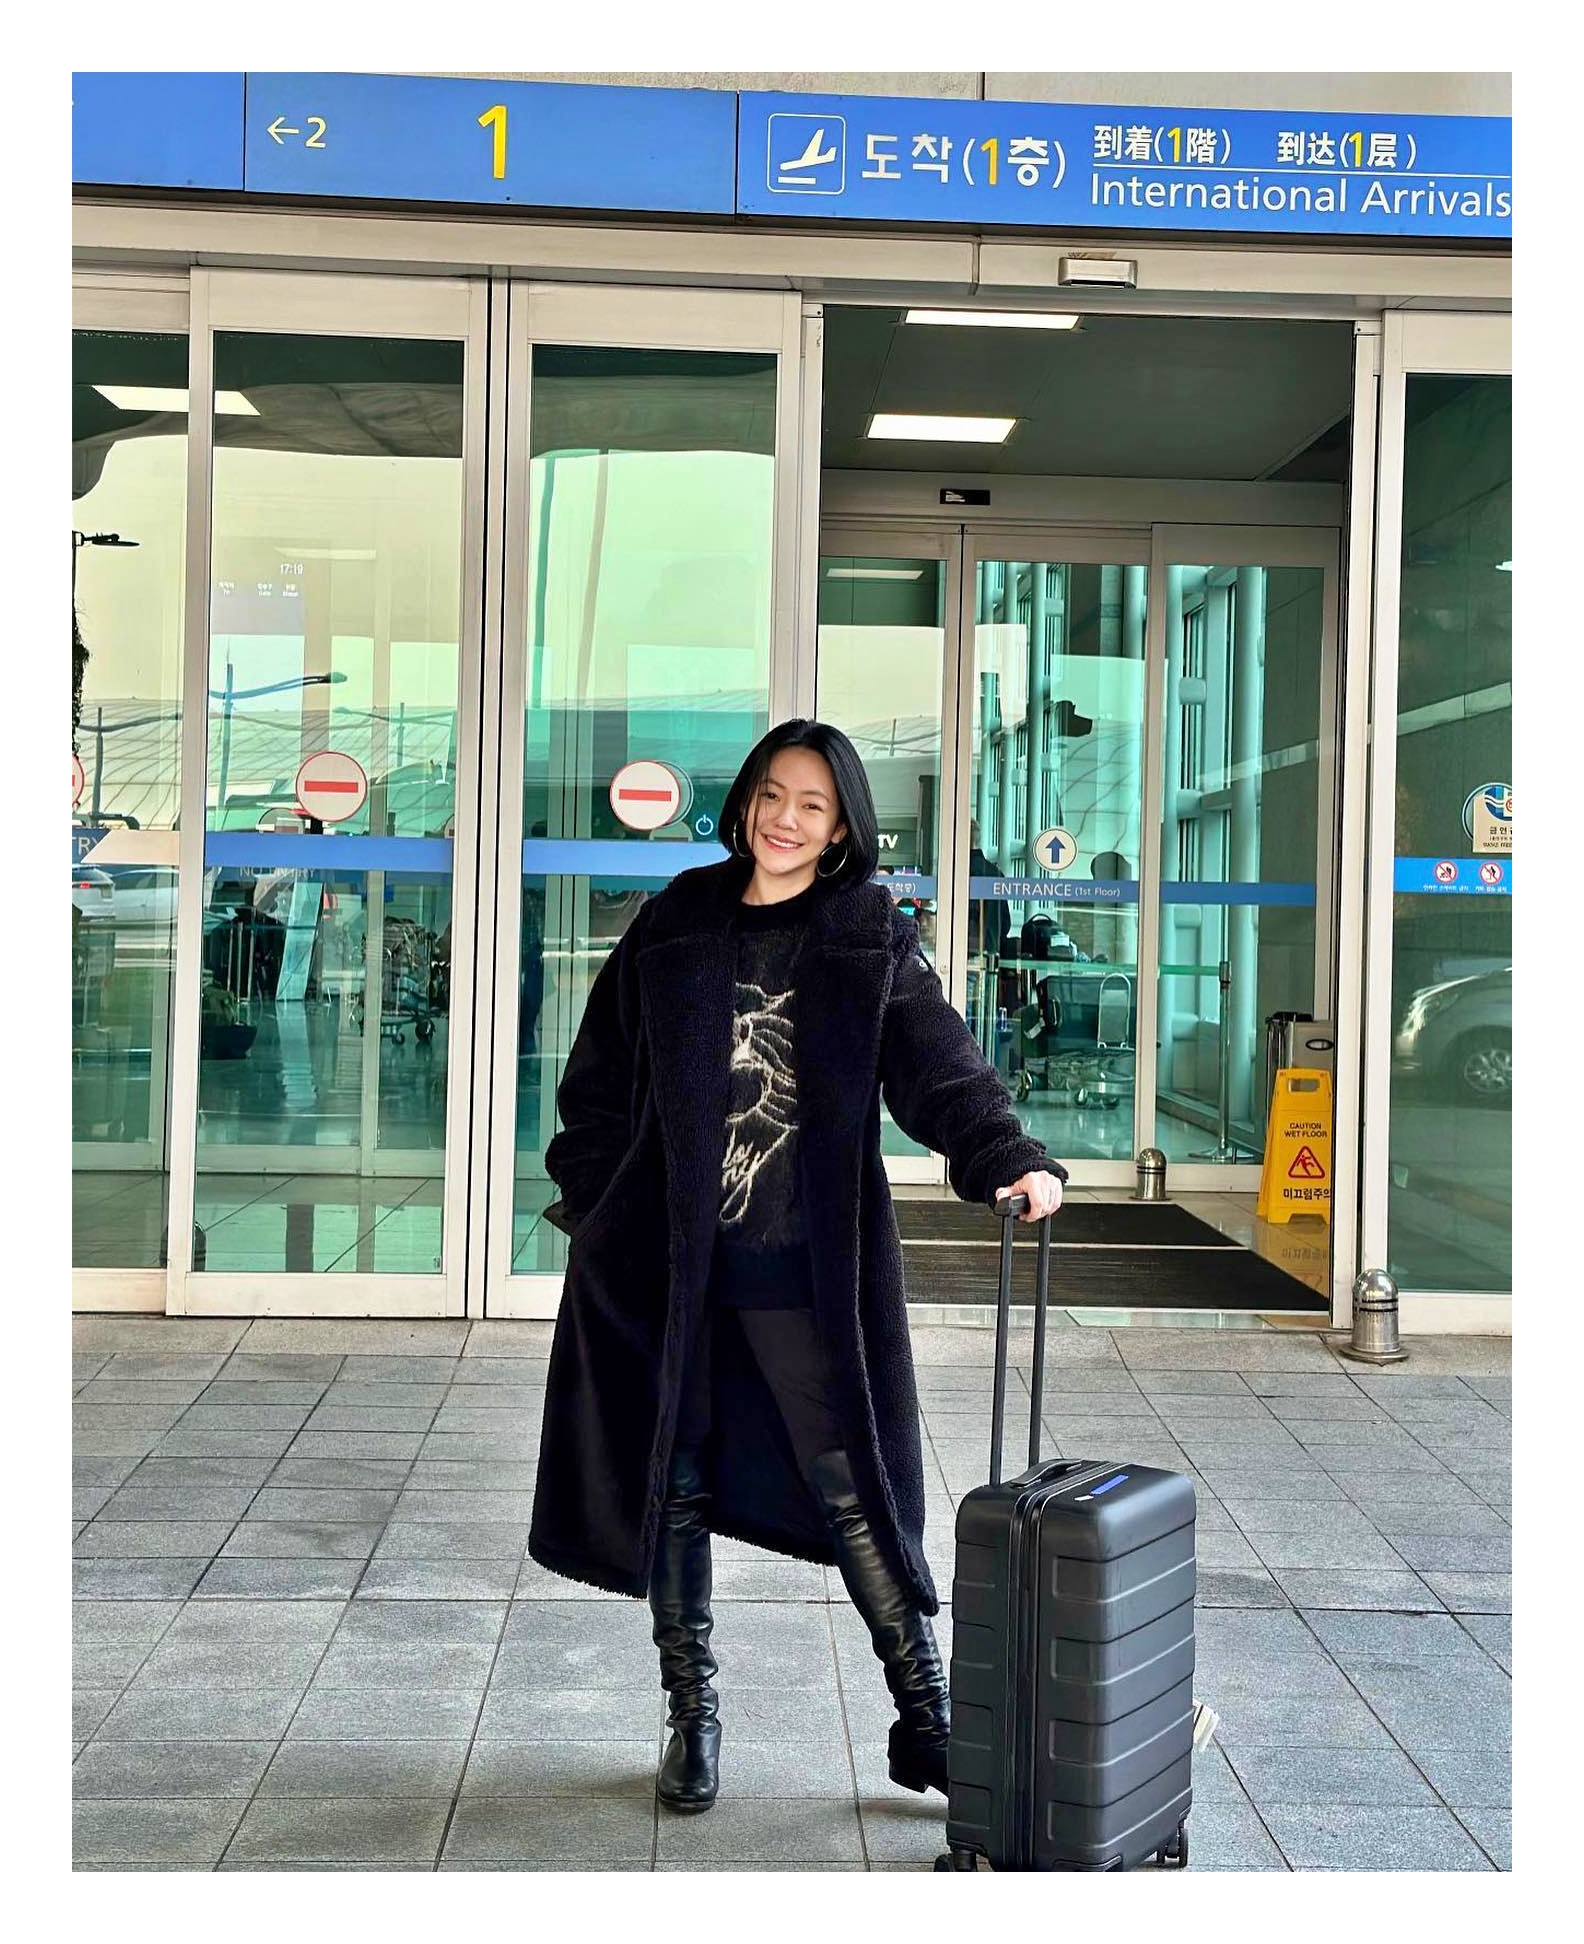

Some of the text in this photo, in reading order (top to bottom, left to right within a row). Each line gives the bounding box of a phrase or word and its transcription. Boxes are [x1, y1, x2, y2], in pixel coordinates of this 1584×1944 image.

[306, 117, 327, 148] 2
[478, 105, 508, 179] 1
[861, 133, 1066, 189] 도착(1층)
[1091, 172, 1512, 217] International Arrivals
[993, 882, 1121, 898] ENTRANCE (1st Floor)
[1284, 1130, 1328, 1138] WET FLOOR
[1289, 1122, 1322, 1130] CAUTION
